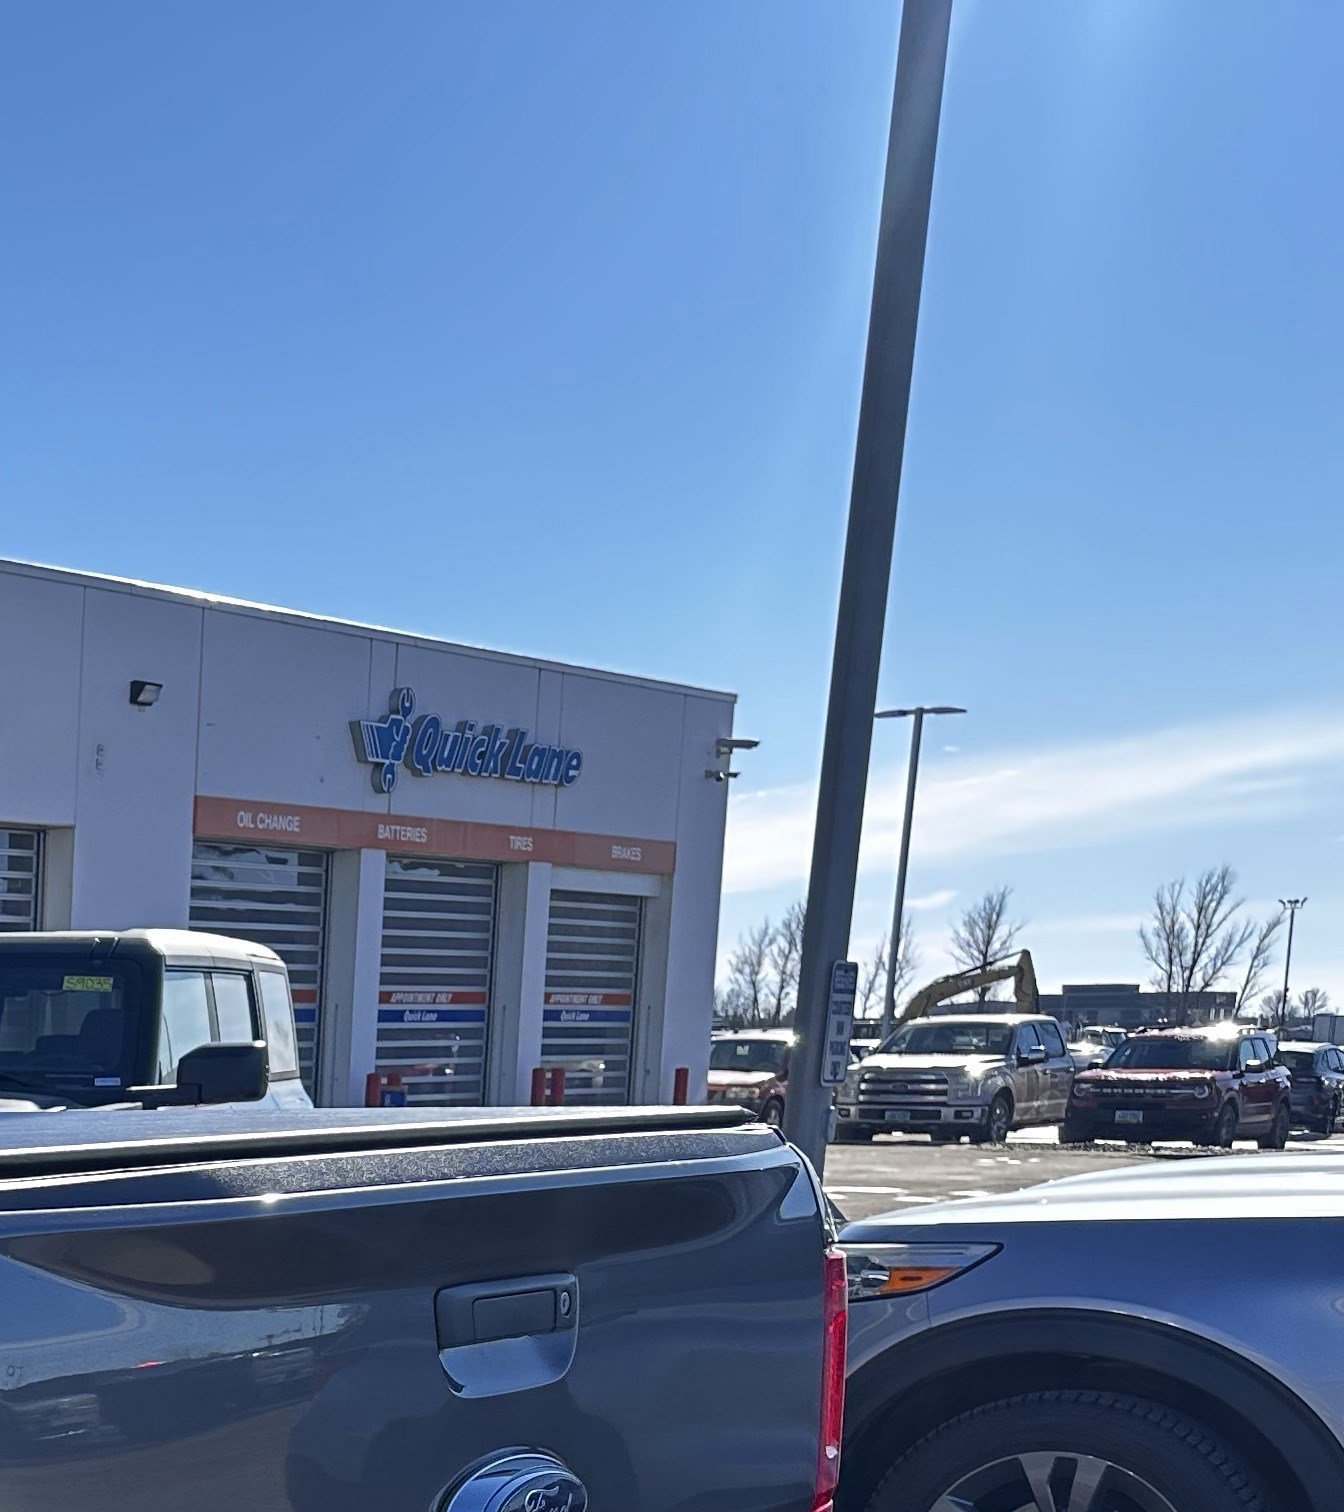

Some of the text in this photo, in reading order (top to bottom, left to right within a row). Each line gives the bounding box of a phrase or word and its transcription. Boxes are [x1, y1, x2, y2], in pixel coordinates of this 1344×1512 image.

[411, 714, 583, 787] Quick Lane
[237, 811, 301, 832] OIL CHANGE
[377, 824, 428, 843] BATTERIES
[509, 835, 533, 852] TIRES
[610, 845, 642, 862] BRAKES
